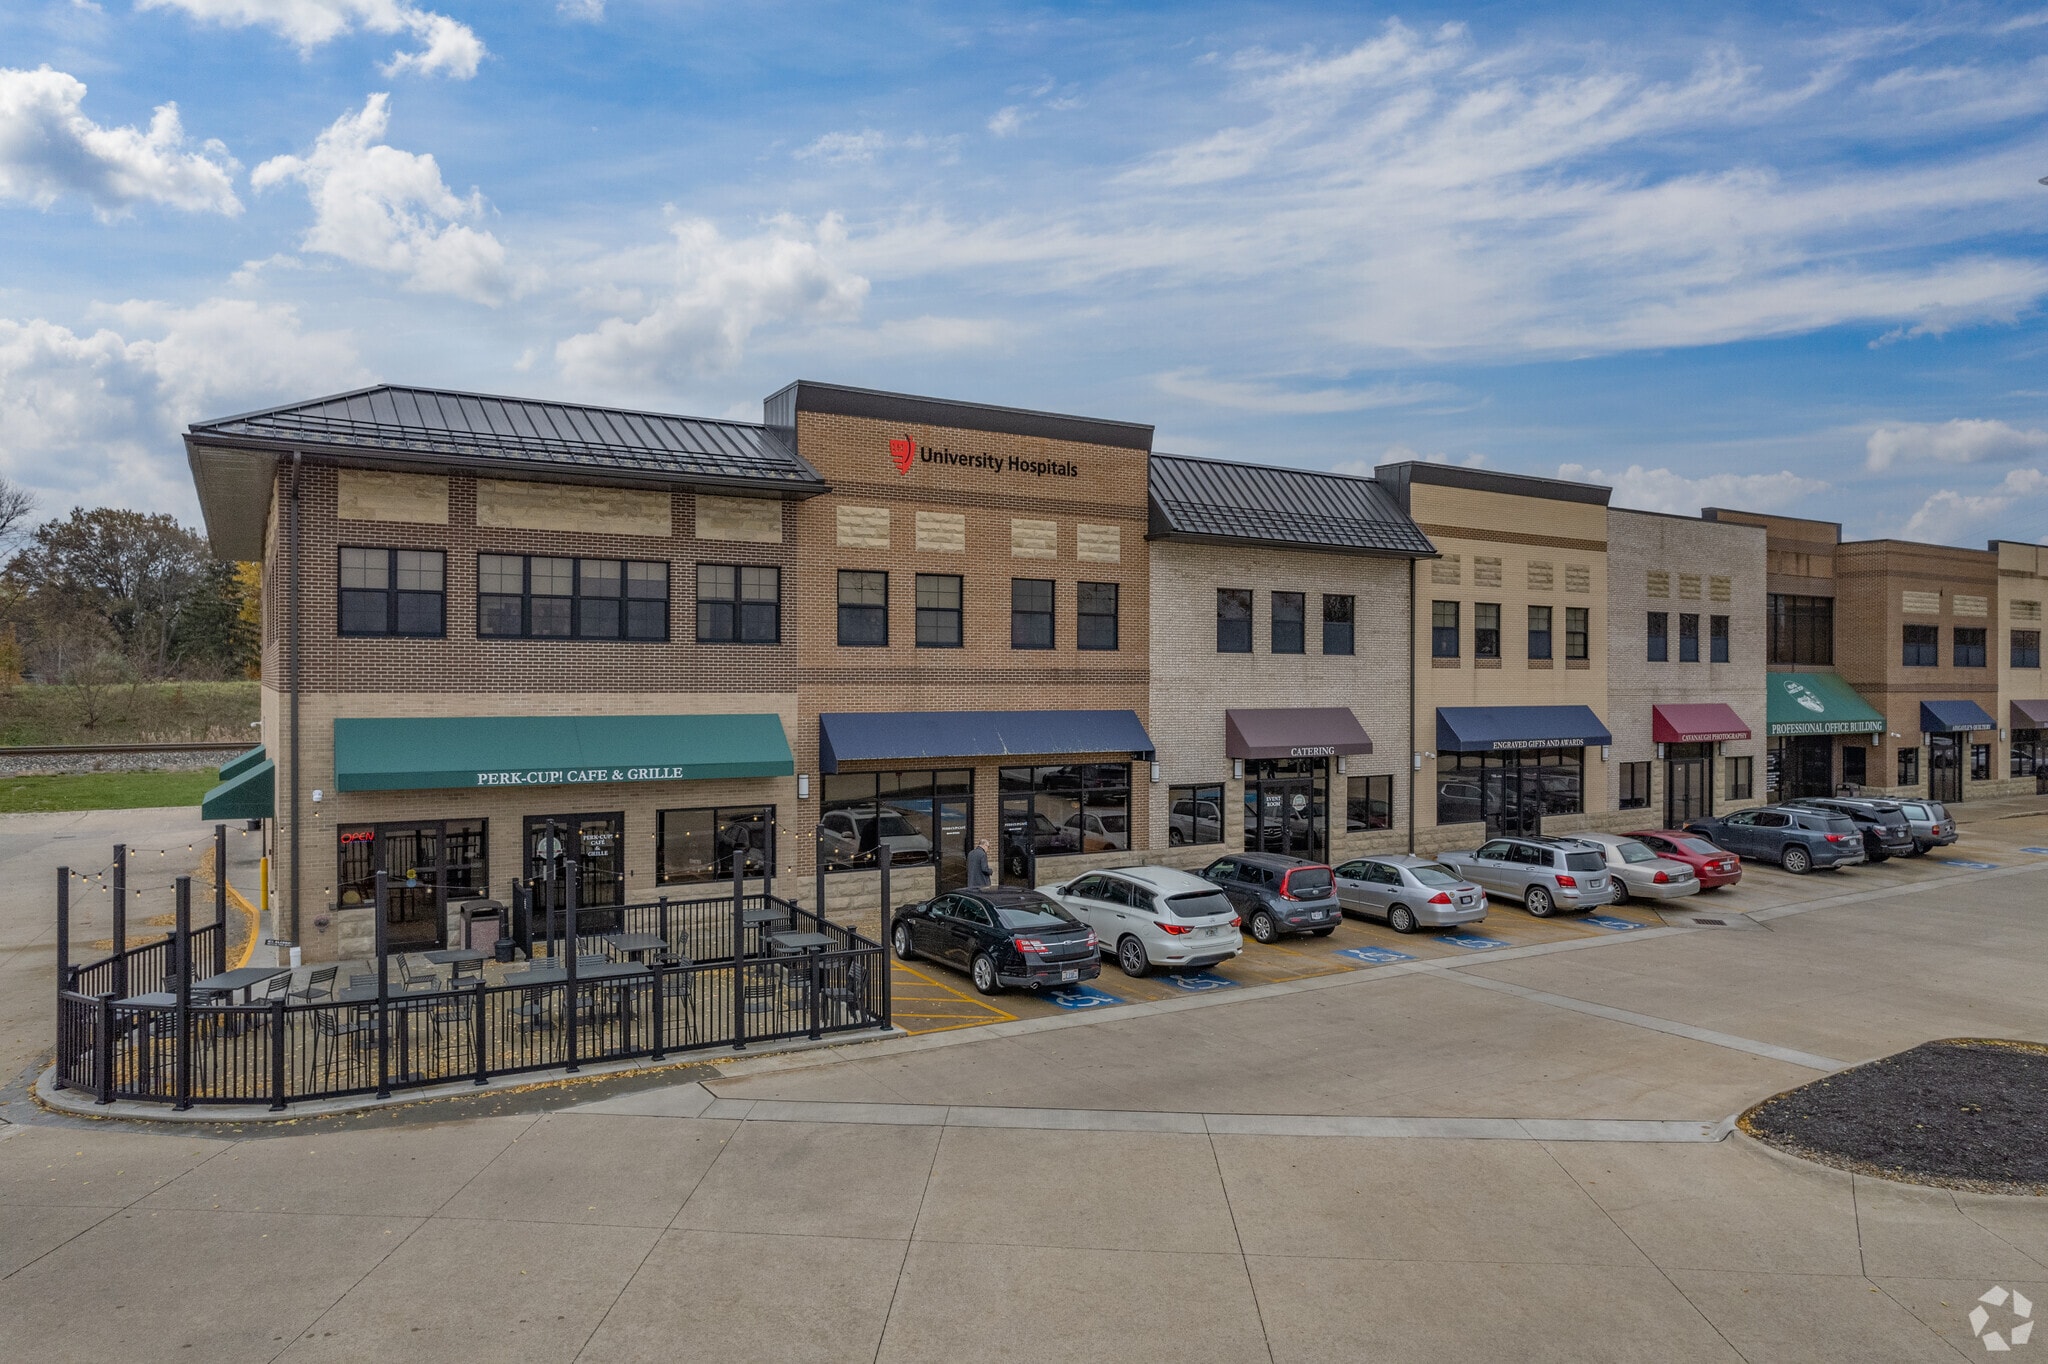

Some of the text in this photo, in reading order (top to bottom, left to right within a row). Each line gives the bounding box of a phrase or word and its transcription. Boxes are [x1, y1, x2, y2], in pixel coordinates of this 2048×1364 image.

[921, 447, 1078, 477] University Hospitals
[1771, 721, 1882, 735] PROFESSIONAL OFFICE BUILDING
[1681, 732, 1747, 741] CAVANAUGH PHOTOGRAPHY
[1493, 738, 1584, 749] ENGRAVED GIFTS AND AWARDS
[1290, 746, 1335, 757] CATERING
[477, 767, 684, 785] PERK-CUP! CAFE & GRILLE
[341, 831, 375, 844] OPEN
